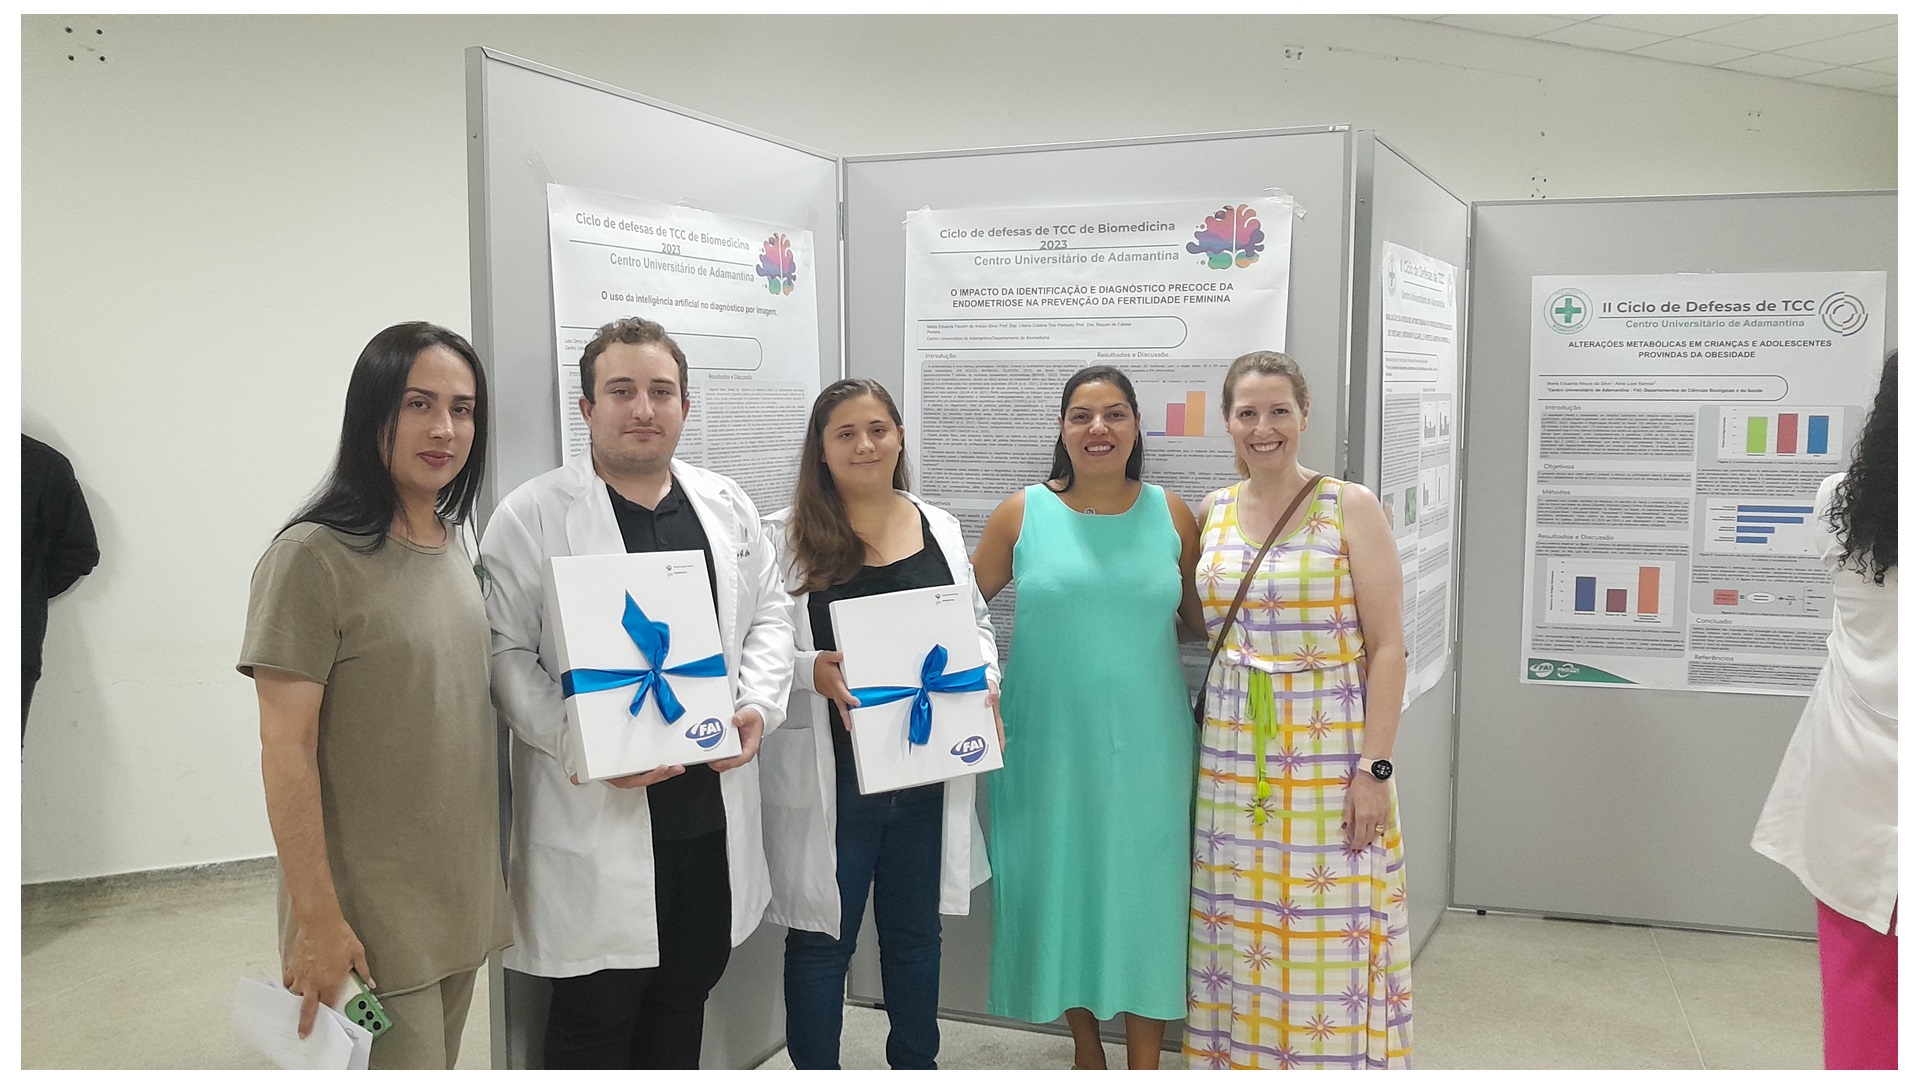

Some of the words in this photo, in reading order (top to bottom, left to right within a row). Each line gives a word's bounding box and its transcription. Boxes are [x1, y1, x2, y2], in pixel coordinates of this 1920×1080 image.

[576, 213, 600, 226] Ciclo
[604, 217, 616, 229] de
[619, 220, 654, 235] defesas
[656, 226, 667, 237] de
[669, 228, 686, 240] TCC
[688, 232, 699, 242] de
[701, 233, 749, 250] Biomedicina
[940, 229, 967, 238] Ciclo
[970, 228, 984, 237] de
[988, 227, 1032, 237] defesas
[1035, 226, 1049, 235] de
[1053, 225, 1076, 235] TCC
[1080, 224, 1094, 234] de
[1099, 221, 1175, 233] Biomedicina
[661, 243, 680, 255] 2023
[1040, 240, 1067, 250] 2023
[974, 256, 1011, 266] Centro
[1015, 252, 1087, 264] Universitário
[1091, 252, 1104, 263] de
[1108, 250, 1179, 262] Adamantina
[610, 253, 641, 268] Centro
[644, 257, 695, 274] Universitário
[698, 265, 707, 276] de
[710, 267, 754, 282] Adamantina
[960, 288, 999, 296] IMPACTO
[1016, 285, 1087, 296] IDENTIFICAÇÃO
[1090, 285, 1096, 294] E
[1099, 283, 1165, 293] DIAGNÓSTICO
[1168, 283, 1216, 292] PRECOCE
[1219, 282, 1234, 291] DA
[601, 291, 607, 300] O
[626, 294, 634, 302] da
[675, 299, 699, 308] artificial
[700, 301, 708, 309] no
[710, 302, 744, 313] diagnóstico
[952, 299, 1023, 307] ENDOMETRIOSE
[1041, 297, 1099, 307] PREVENÇÃO
[1102, 297, 1115, 305] DA
[1118, 296, 1180, 305] FERTILIDADE
[1184, 295, 1231, 303] FEMININA
[1603, 303, 1611, 312] II
[1617, 301, 1656, 312] Ciclo
[1661, 301, 1681, 312] de
[1686, 300, 1750, 312] Defesas
[1756, 300, 1776, 311] de
[1782, 300, 1814, 311] TCC
[1662, 319, 1725, 328] Universitário
[1569, 340, 1624, 348] ALTERAÇÕES
[700, 721, 721, 736] FAI
[963, 739, 984, 752] FAI
